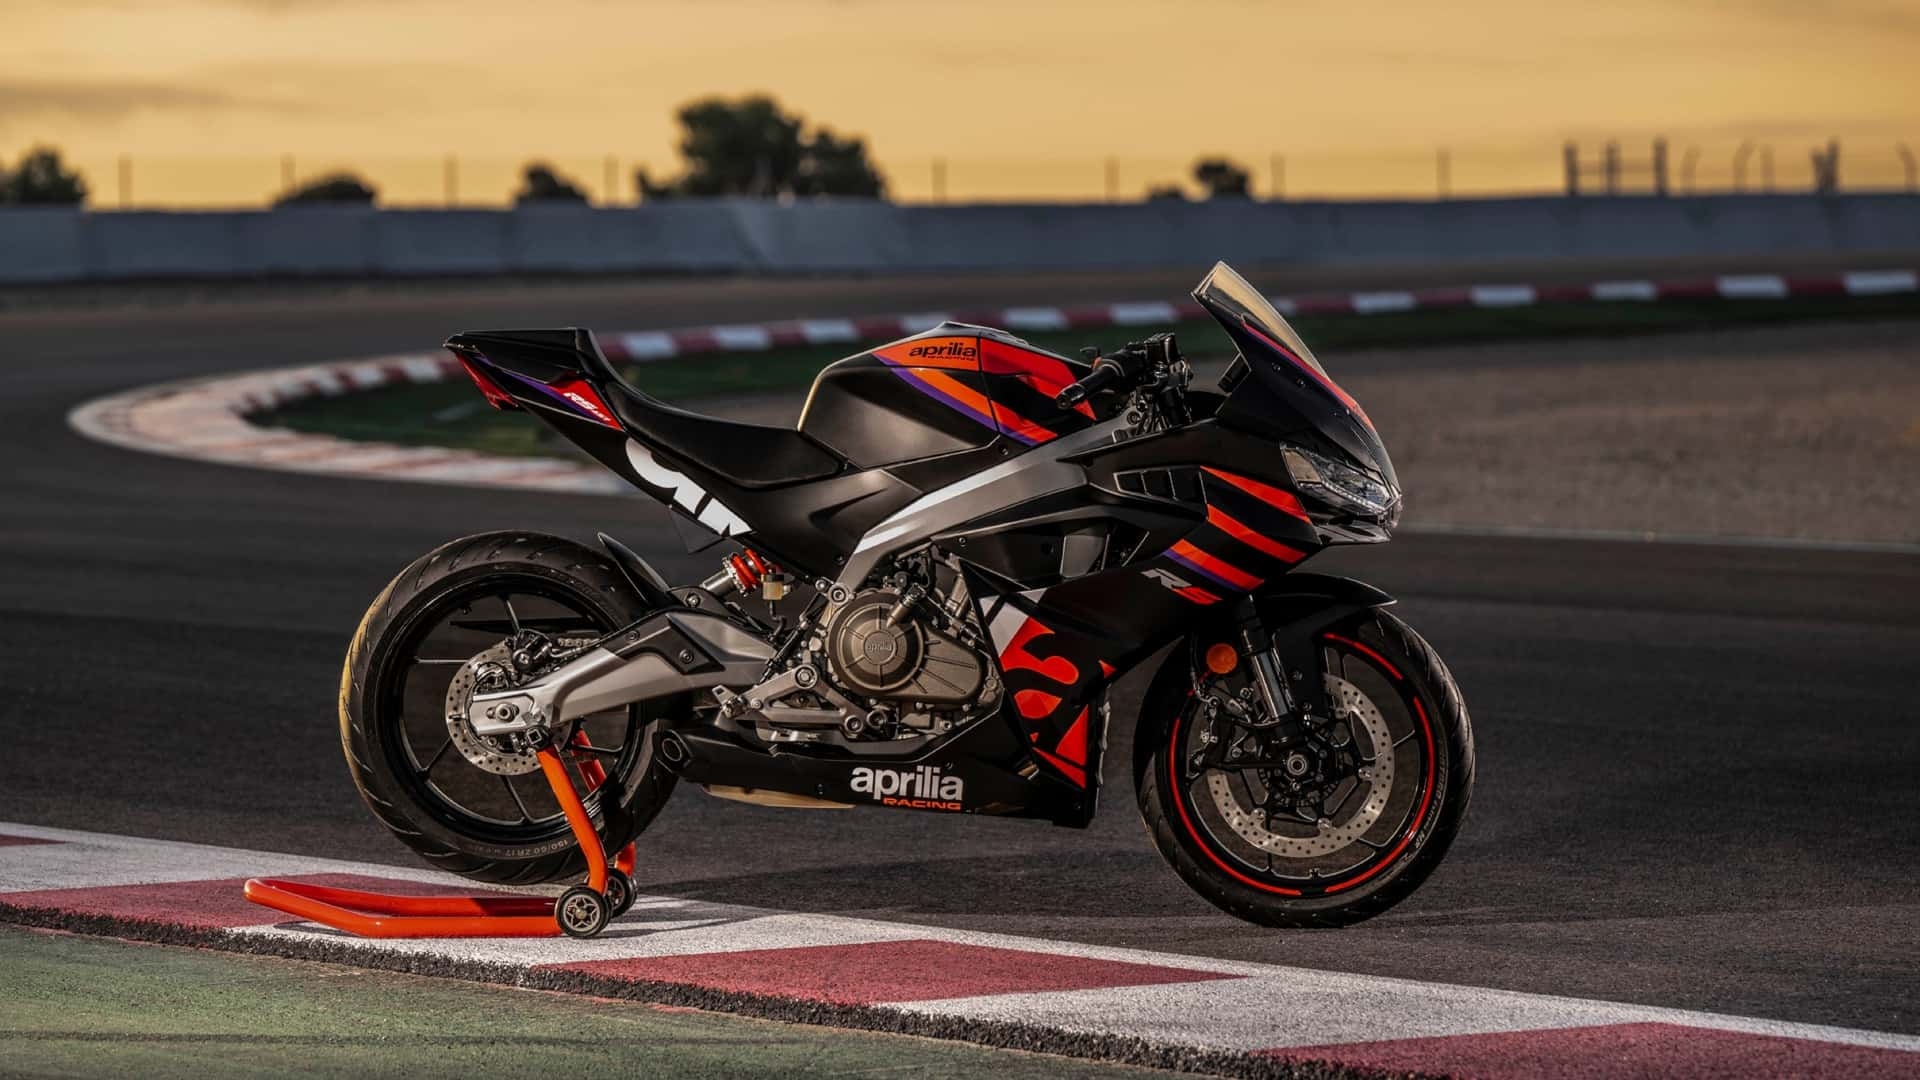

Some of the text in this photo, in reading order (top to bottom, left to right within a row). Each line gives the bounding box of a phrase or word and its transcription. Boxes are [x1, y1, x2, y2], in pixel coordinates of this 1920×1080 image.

[909, 342, 977, 357] aprilia
[1140, 567, 1224, 606] RS
[850, 765, 963, 800] aprilia
[883, 798, 961, 810] RACING
